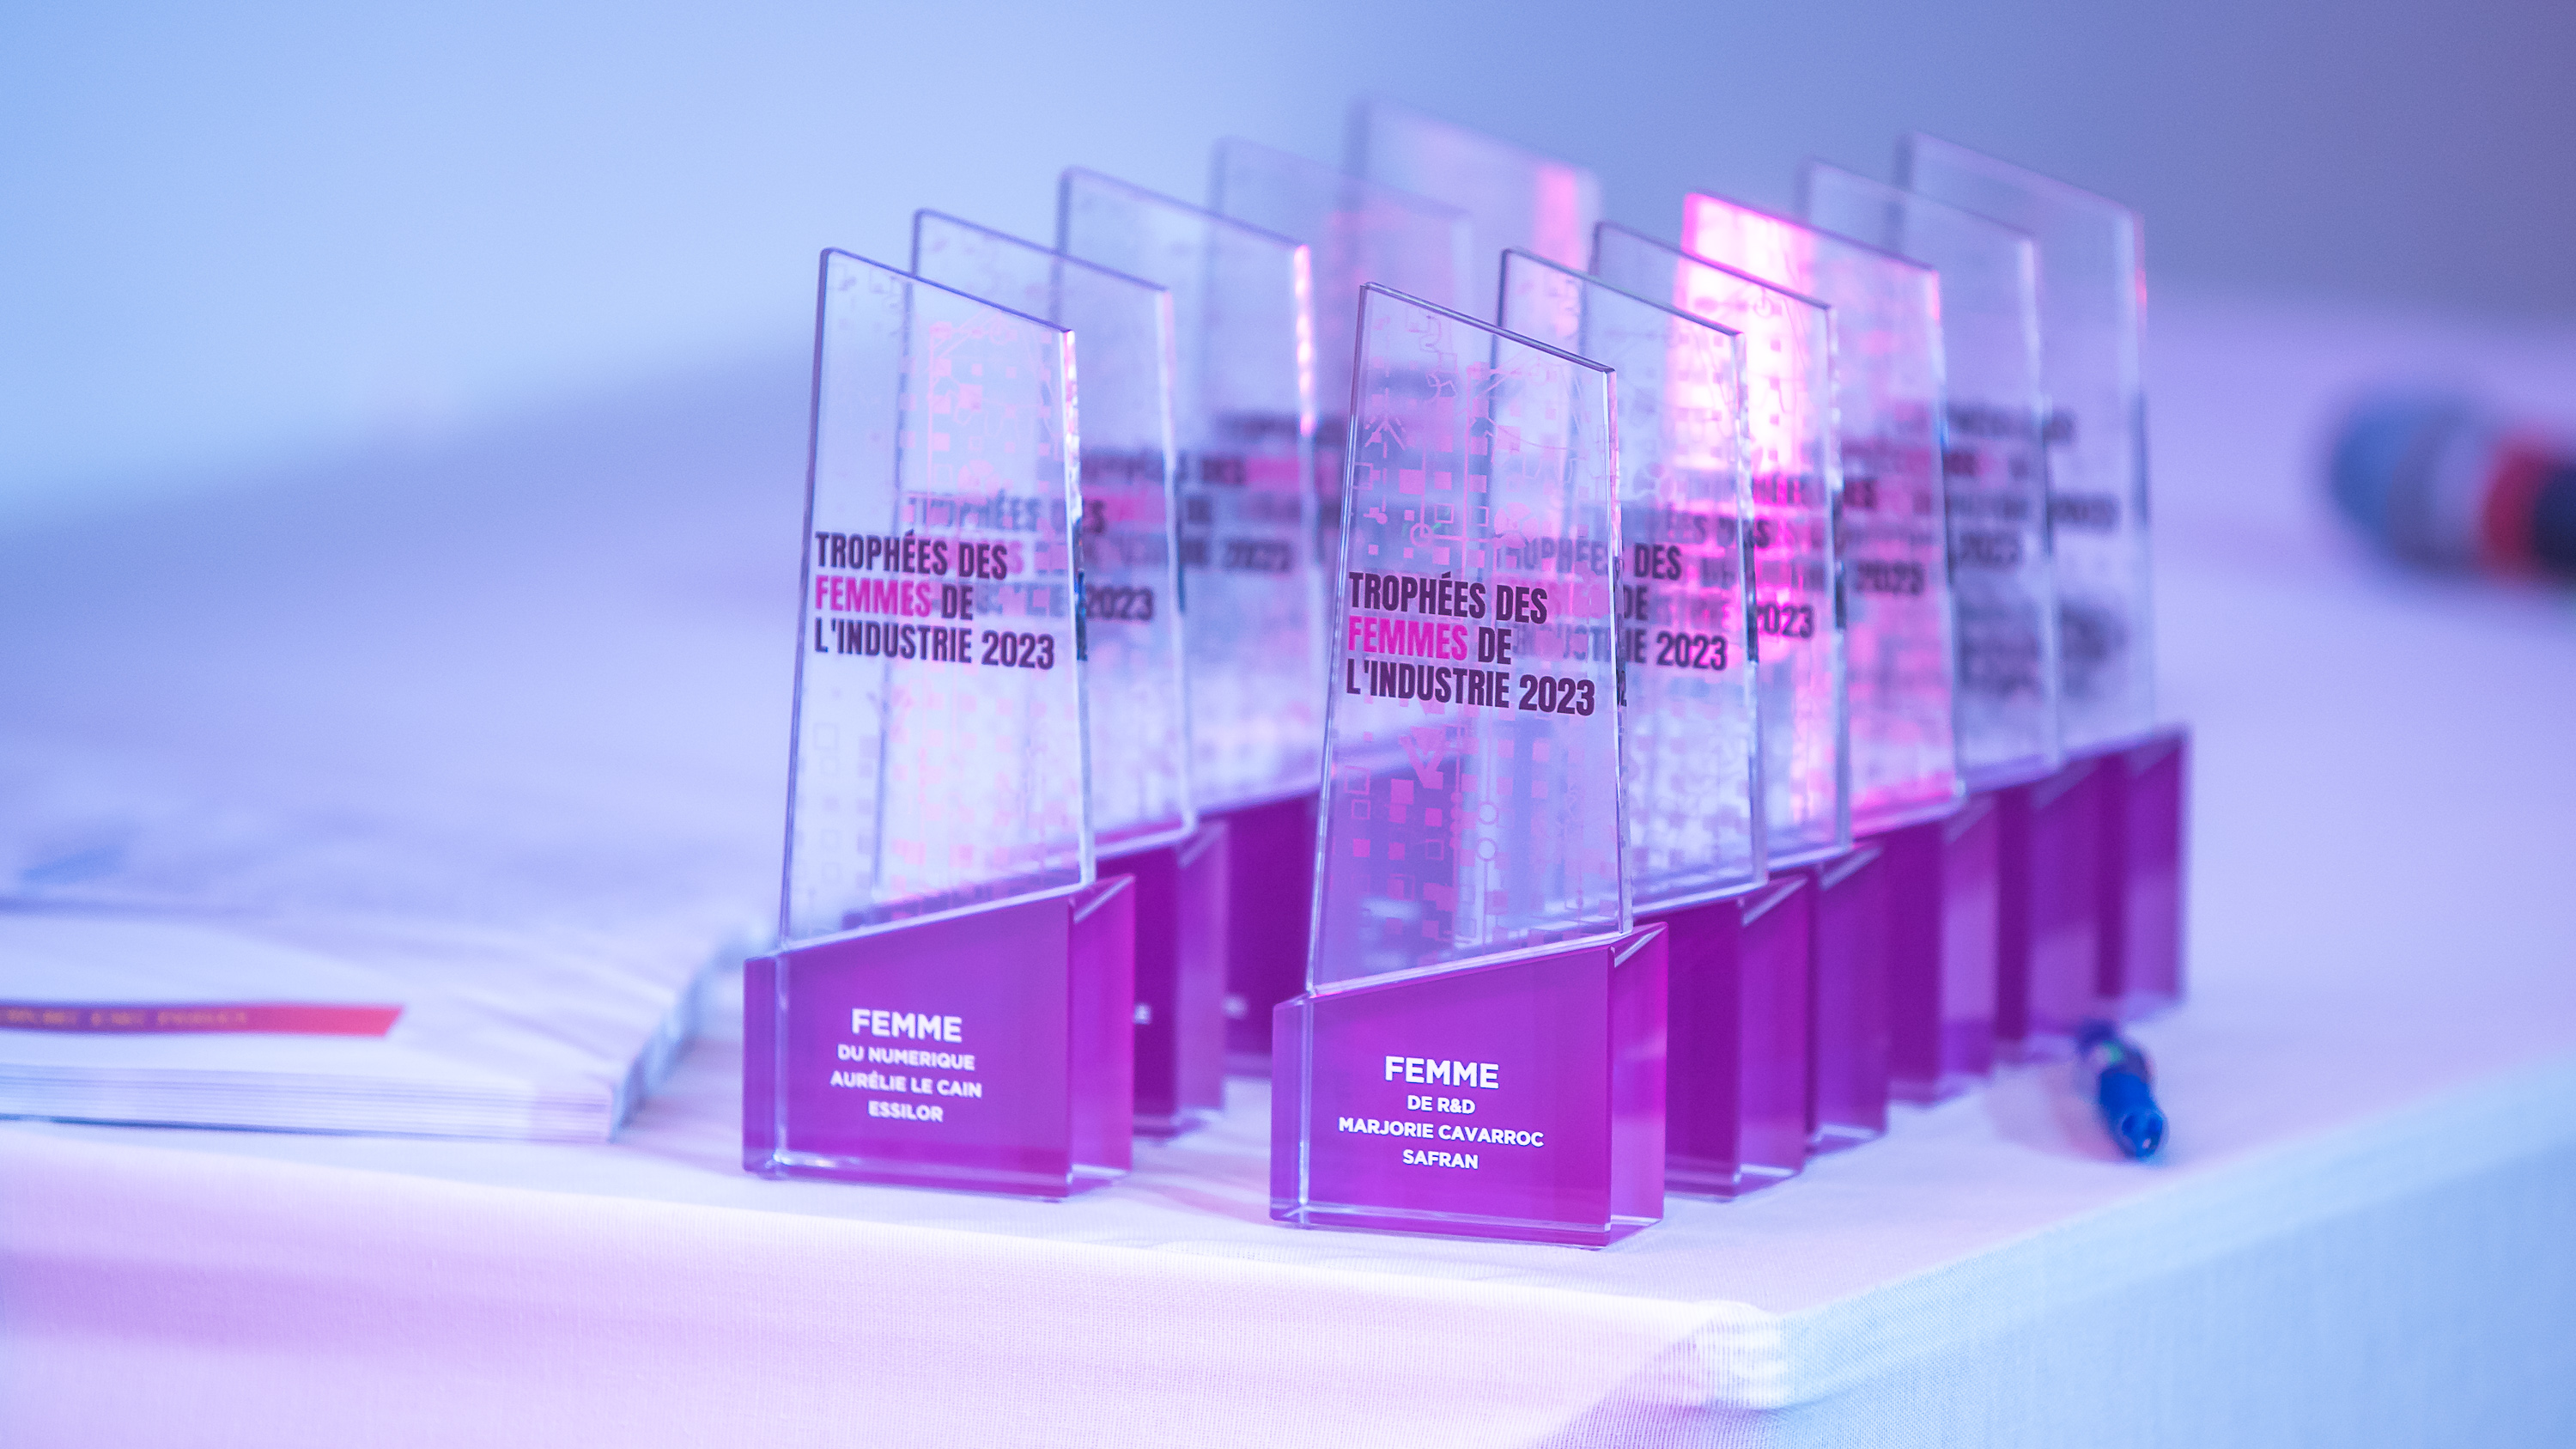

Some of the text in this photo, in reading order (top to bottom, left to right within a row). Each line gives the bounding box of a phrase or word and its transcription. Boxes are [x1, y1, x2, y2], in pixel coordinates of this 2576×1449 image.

[815, 529, 948, 575] TROPHÉES
[958, 540, 1008, 580] DES
[1635, 543, 1682, 581] DES
[815, 575, 932, 618] FEMMES
[941, 583, 974, 620] DE
[1348, 571, 1486, 619] TROPHÉES
[1496, 584, 1548, 624] DES
[814, 618, 1054, 670] L'INDUSTRIE 2023
[1347, 617, 1468, 661] FEMMES
[1478, 627, 1512, 666] DE
[1656, 631, 1728, 671] 2023
[1346, 659, 1595, 716] L'INDUSTRIE 2023
[851, 1008, 962, 1043] FEMME
[837, 1044, 975, 1071] DU NUMERIQUE
[1385, 1056, 1499, 1089] FEMME
[830, 1070, 982, 1099] AURÉLIE LE CAIN
[868, 1100, 944, 1123] ESSILOR
[1407, 1095, 1475, 1115] DE R&D
[1339, 1117, 1544, 1148] MARJORIE CAVARROC
[1402, 1149, 1479, 1170] SAFRAN
